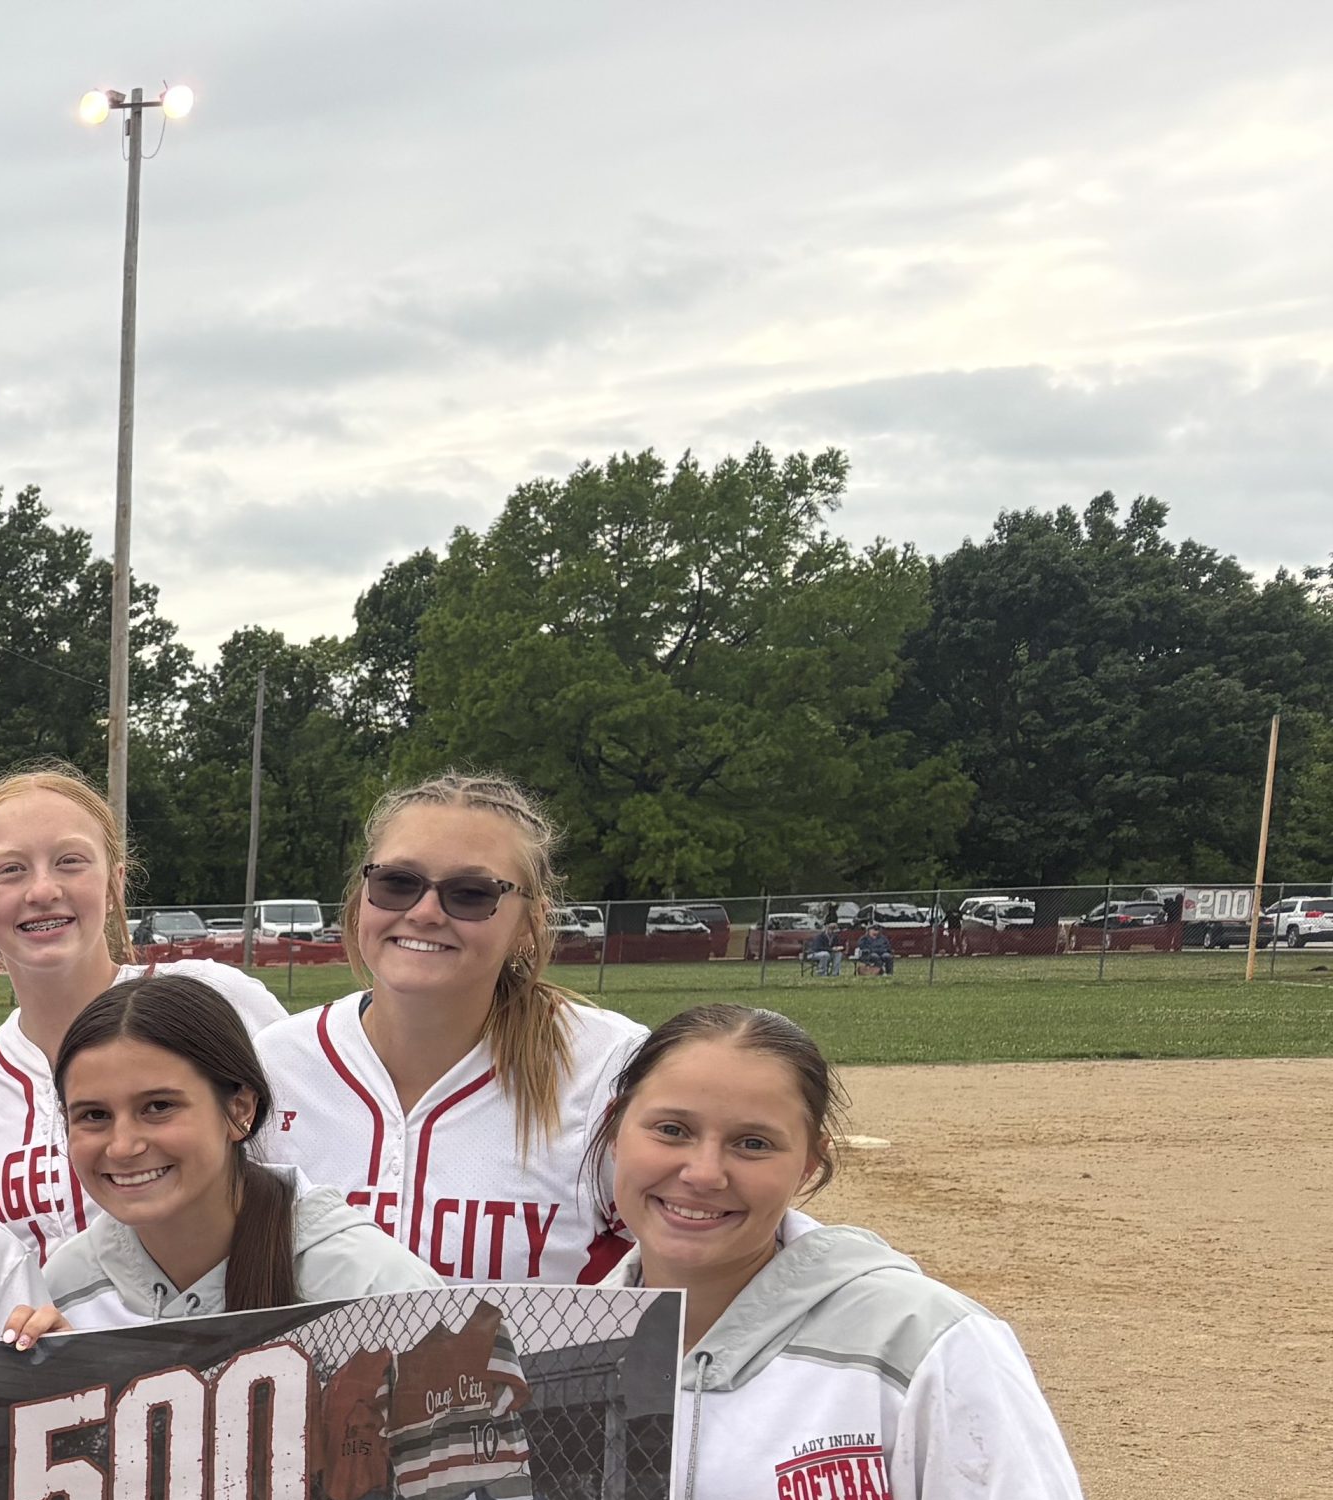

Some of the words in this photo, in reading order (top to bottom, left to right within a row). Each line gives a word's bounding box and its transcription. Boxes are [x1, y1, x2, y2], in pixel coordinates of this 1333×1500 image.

[1195, 889, 1250, 919] 200
[430, 1198, 560, 1280] CITY
[469, 1422, 499, 1465] 10
[792, 1437, 825, 1457] LADY
[829, 1433, 876, 1448] INDIAN
